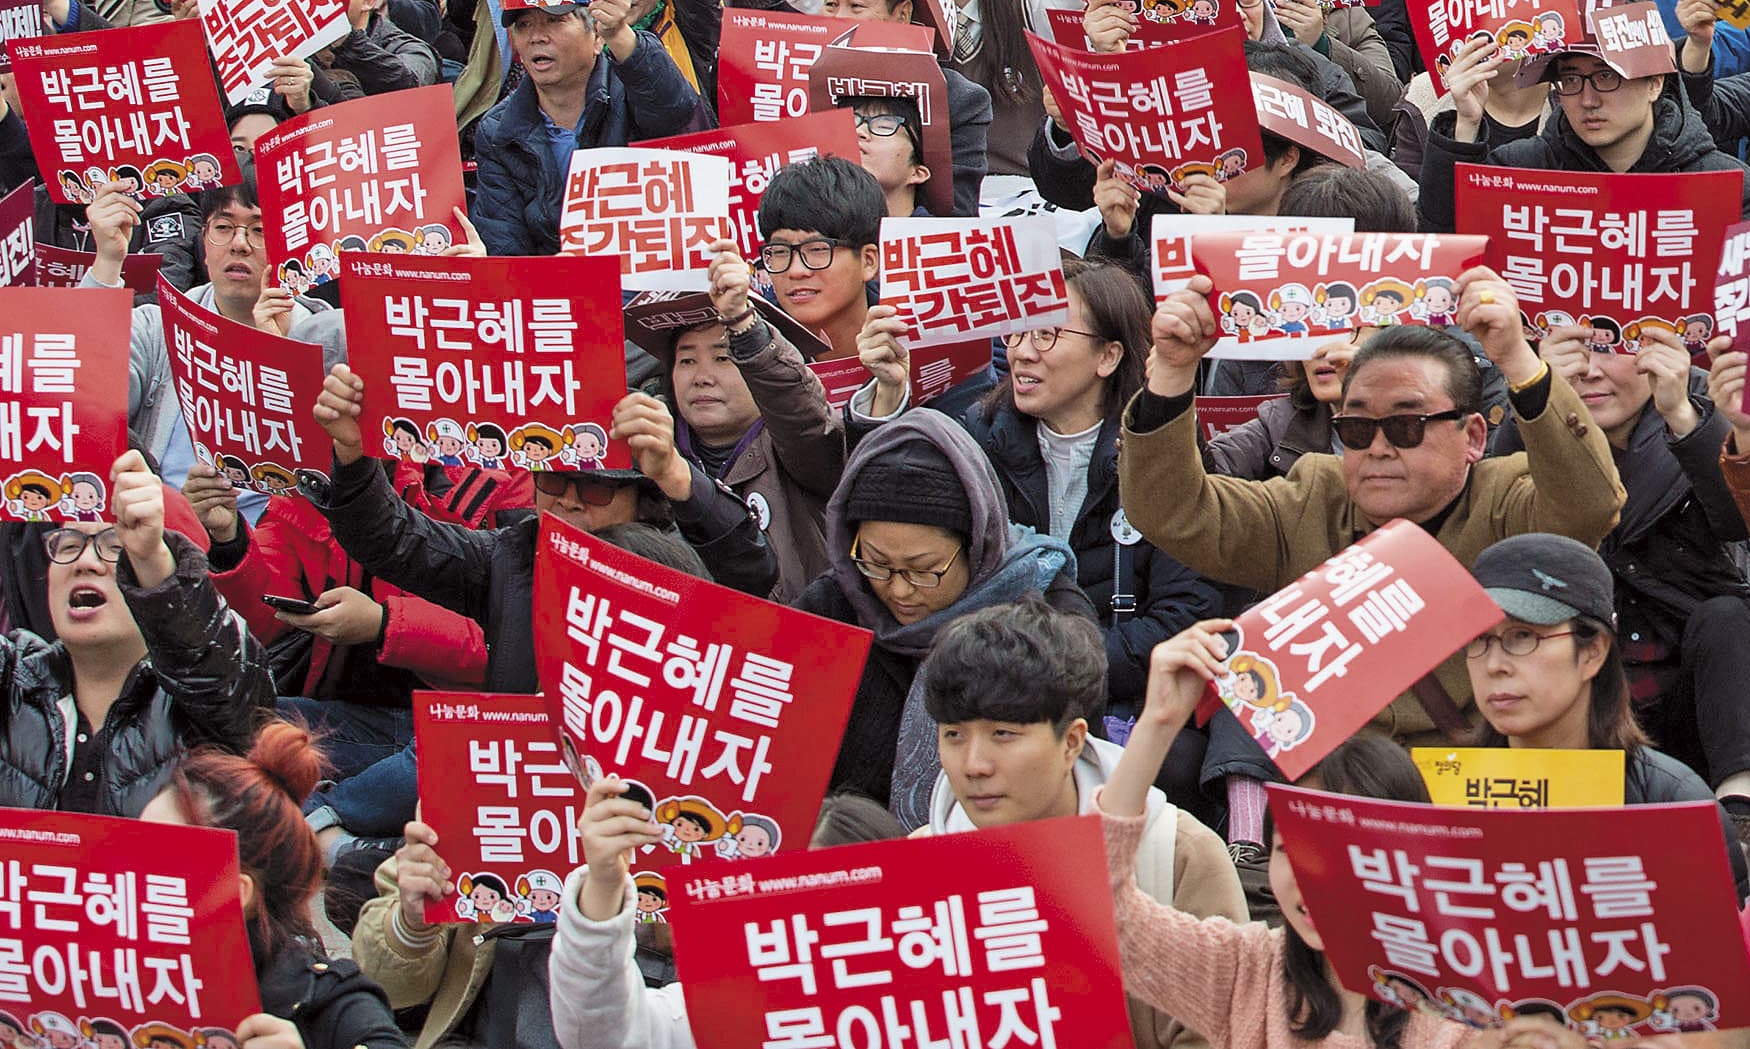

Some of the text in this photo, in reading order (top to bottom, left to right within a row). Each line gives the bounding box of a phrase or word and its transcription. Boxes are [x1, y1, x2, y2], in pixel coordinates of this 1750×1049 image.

[44, 44, 97, 56] www.nanum.com
[41, 57, 180, 112] 박근혜를
[1059, 66, 1214, 118] 박근혜를
[54, 106, 191, 162] 몰아내자
[276, 122, 422, 194] 박근혜를
[282, 180, 428, 248] 몰아내자
[568, 159, 695, 212] 박근혜
[1469, 173, 1598, 196] 나눔문화 www.nanum.com
[883, 225, 1023, 291] 박근혜
[1235, 234, 1440, 282] 몰아내자
[1502, 204, 1699, 256] 박근혜를
[351, 260, 471, 283] 나눔문화 www.nanum.com
[1503, 263, 1696, 310] 몰아내자
[384, 295, 579, 354] 박근혜를
[173, 322, 296, 414] 박근혜를
[390, 356, 580, 416] 몰아내자
[179, 382, 302, 462] 몰아내자
[566, 584, 794, 729] 박근혜를
[559, 662, 773, 803] 몰아내자
[686, 865, 882, 900] 나눔문화 www.nanum.com
[1349, 845, 1657, 920] 박근혜를
[745, 885, 1049, 995] 박근혜를
[1371, 911, 1670, 990] 몰아내자
